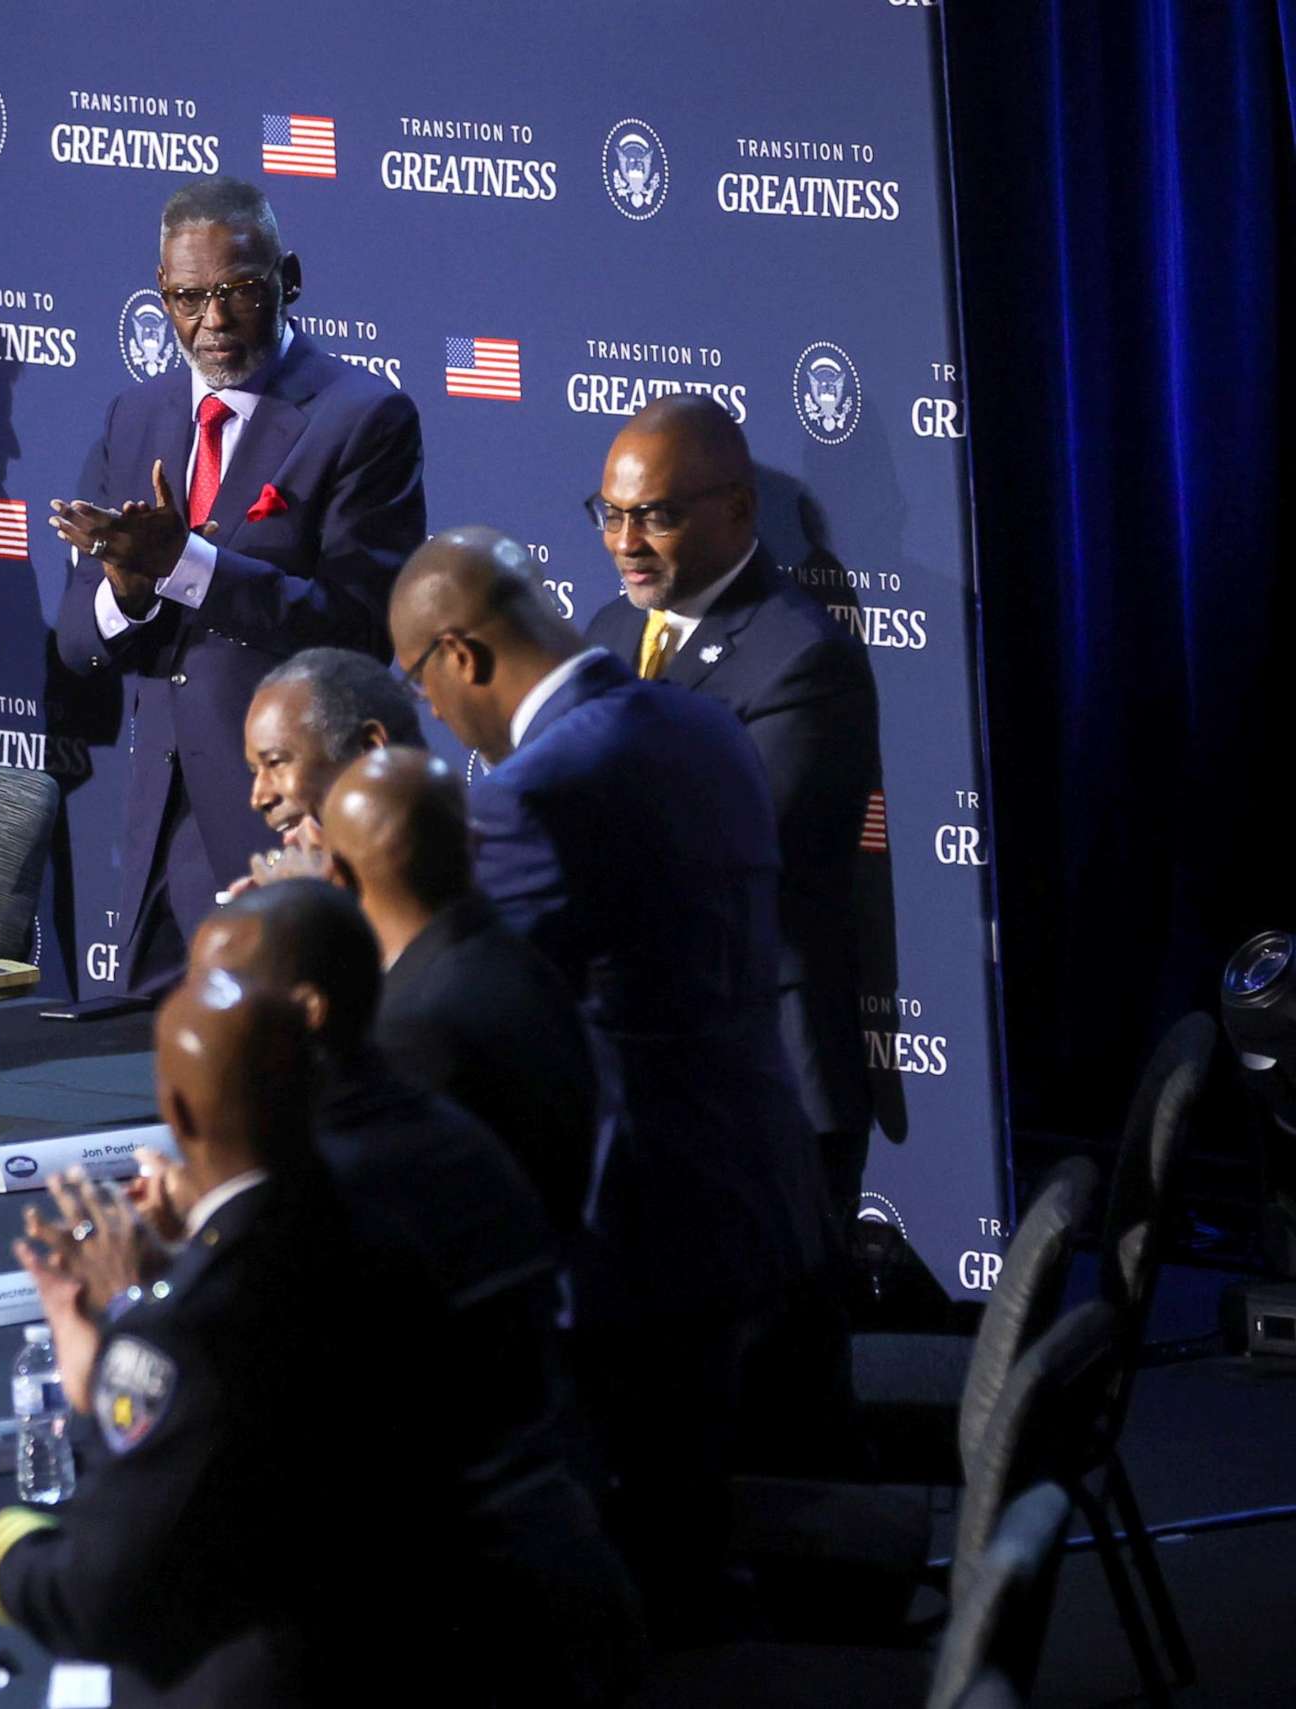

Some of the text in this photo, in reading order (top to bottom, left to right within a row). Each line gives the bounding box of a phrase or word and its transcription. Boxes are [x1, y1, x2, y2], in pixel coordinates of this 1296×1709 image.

[69, 90, 197, 119] TRANSITION TO
[400, 117, 533, 144] TRANSITION TO
[50, 123, 220, 175] GREATNESS
[736, 138, 874, 163] TRANSITION TO
[380, 150, 557, 201] GREATNESS
[717, 172, 900, 221] GREATNESS
[32, 292, 54, 312] TO
[355, 321, 377, 341] TO
[586, 339, 722, 367] TRANSITION TO
[877, 572, 901, 592] TO
[898, 998, 922, 1018] TO
